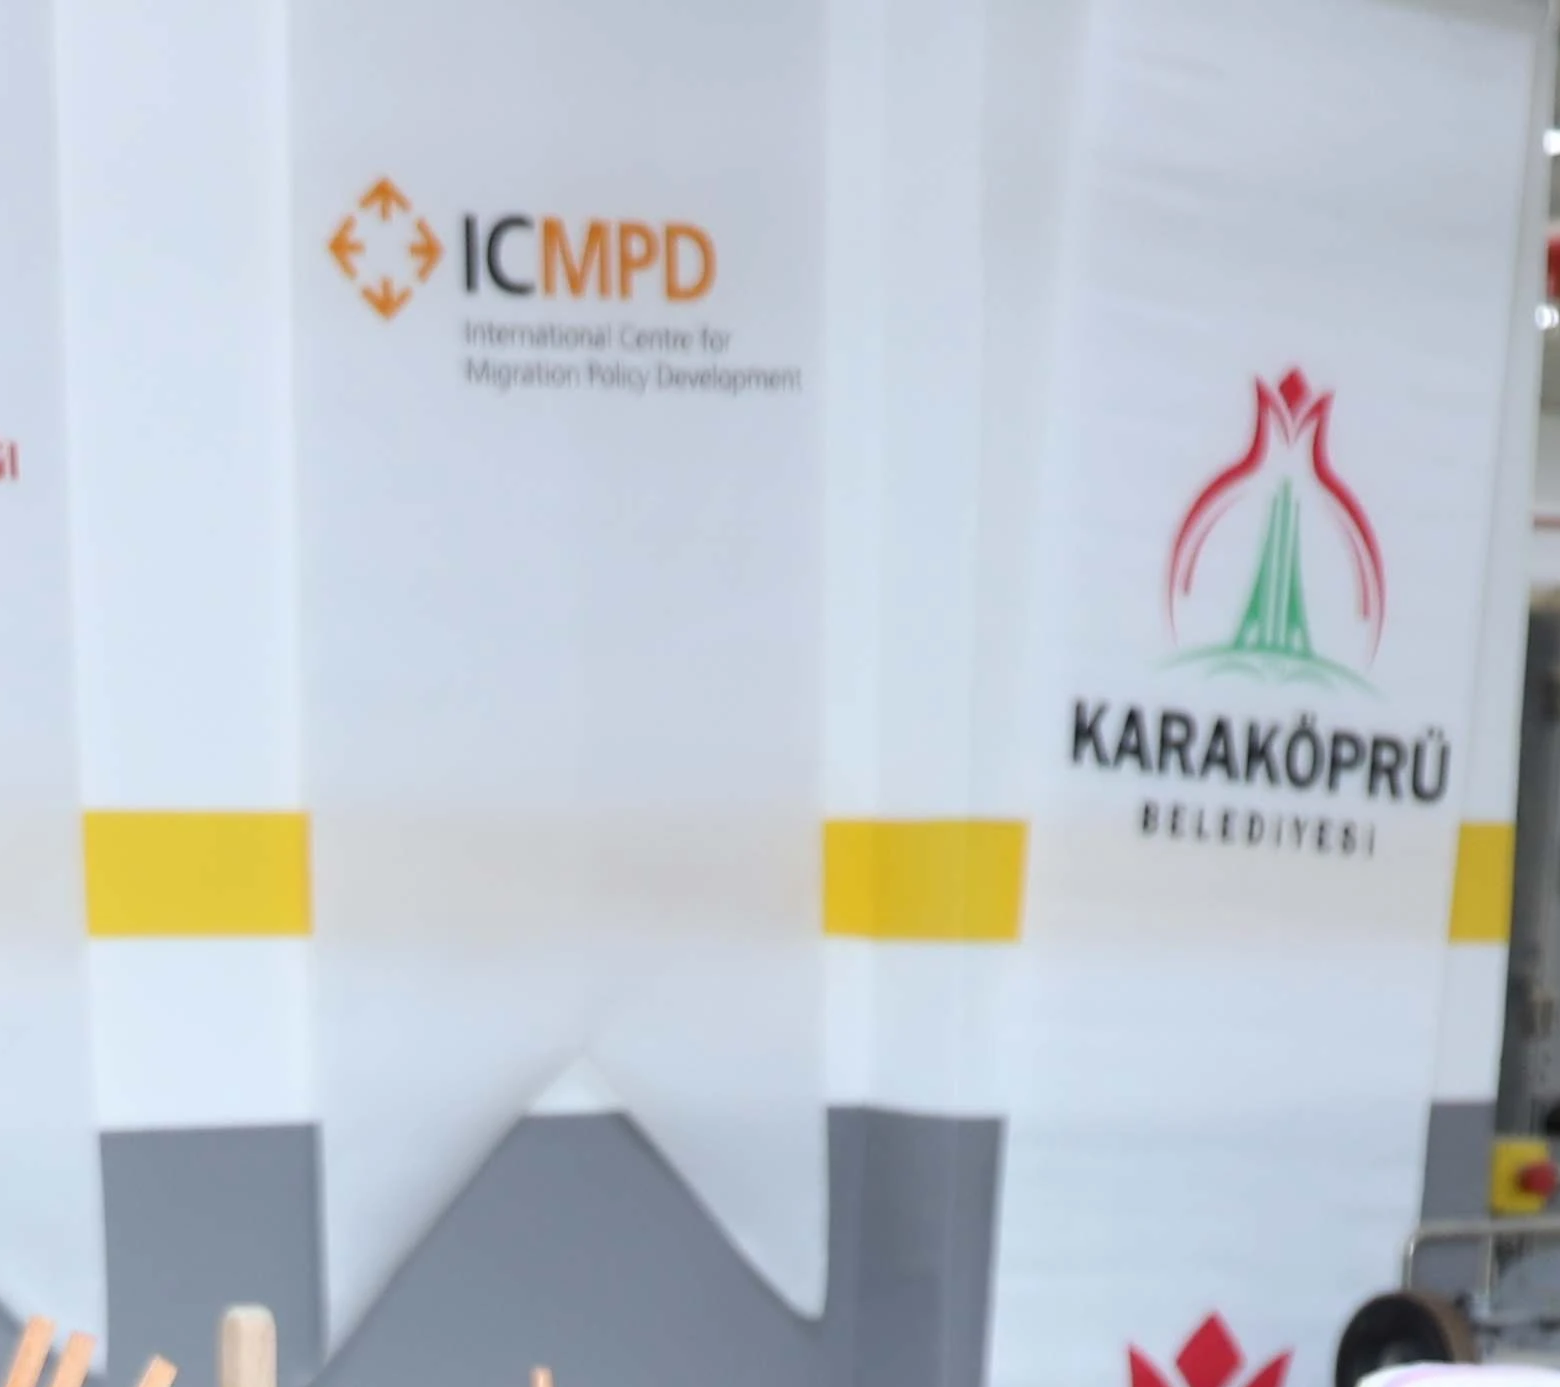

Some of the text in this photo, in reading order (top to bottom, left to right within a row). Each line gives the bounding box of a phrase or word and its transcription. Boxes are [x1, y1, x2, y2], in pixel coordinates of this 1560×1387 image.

[462, 213, 718, 304] ICMPD
[466, 320, 731, 352] International Centre for
[466, 357, 802, 397] Migration Policy Development
[1070, 699, 1451, 805] KARAKÖPRÜ
